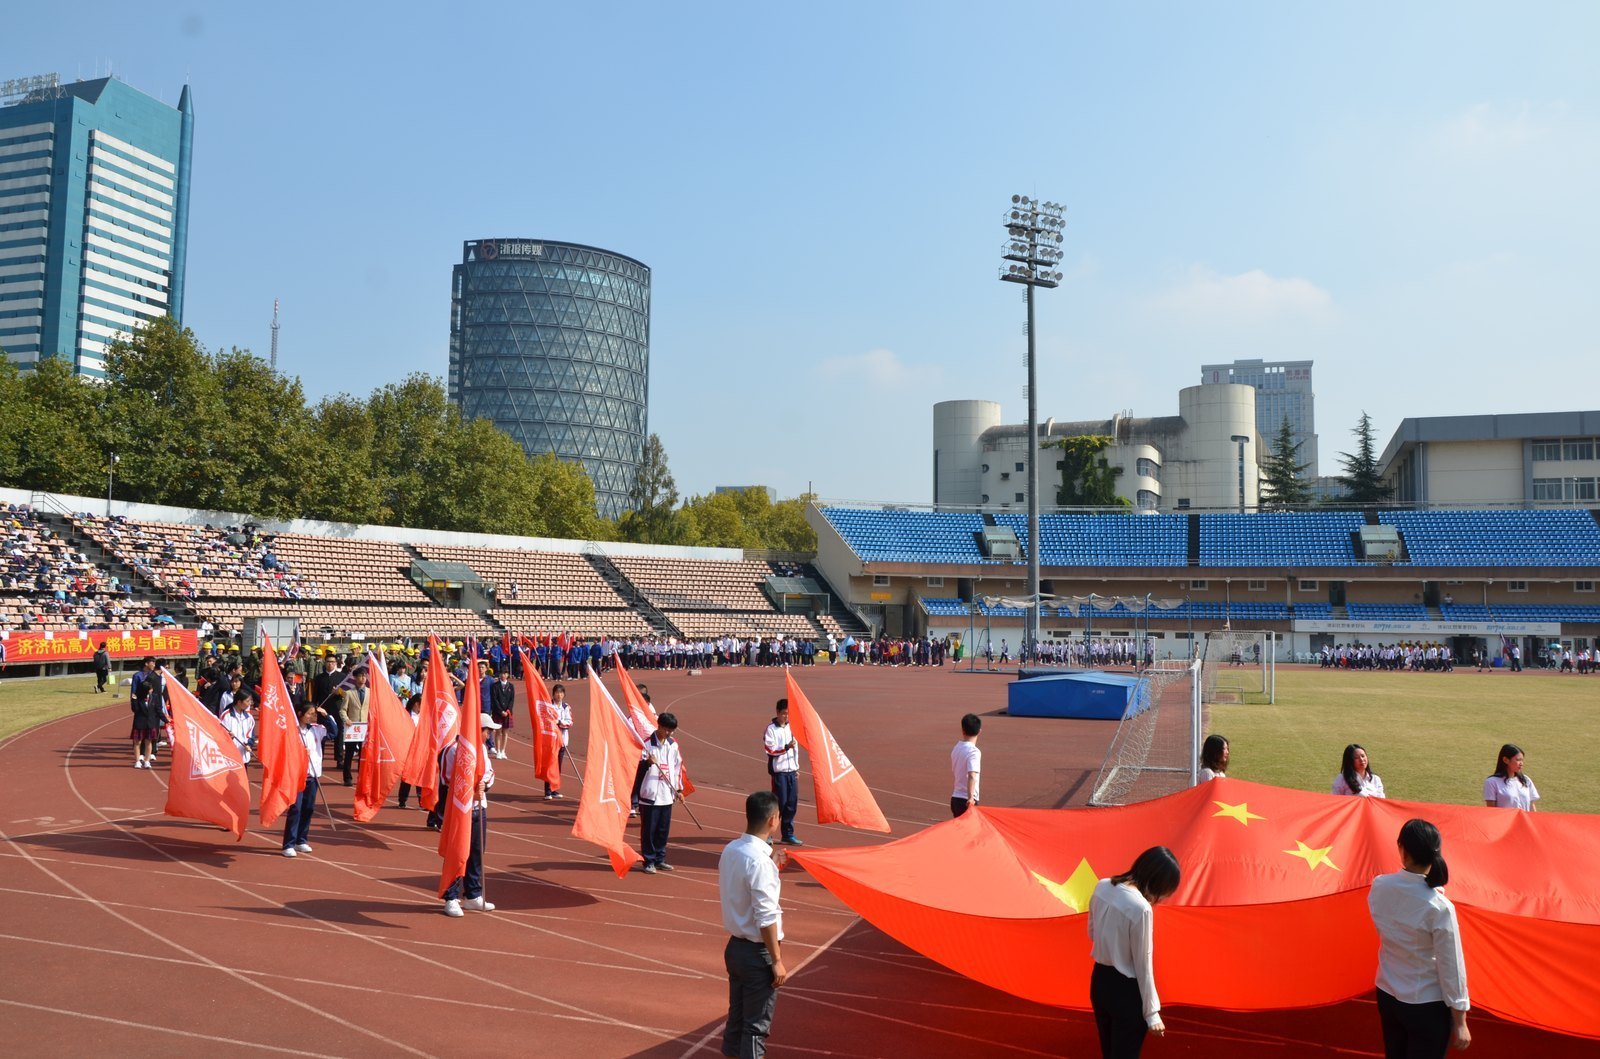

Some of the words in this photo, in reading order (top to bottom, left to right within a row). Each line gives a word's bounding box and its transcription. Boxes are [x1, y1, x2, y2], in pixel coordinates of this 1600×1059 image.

[500, 243, 542, 256] 浙报传媒
[18, 638, 98, 656] 济济杭高人
[106, 635, 182, 653] 锵锵与国行
